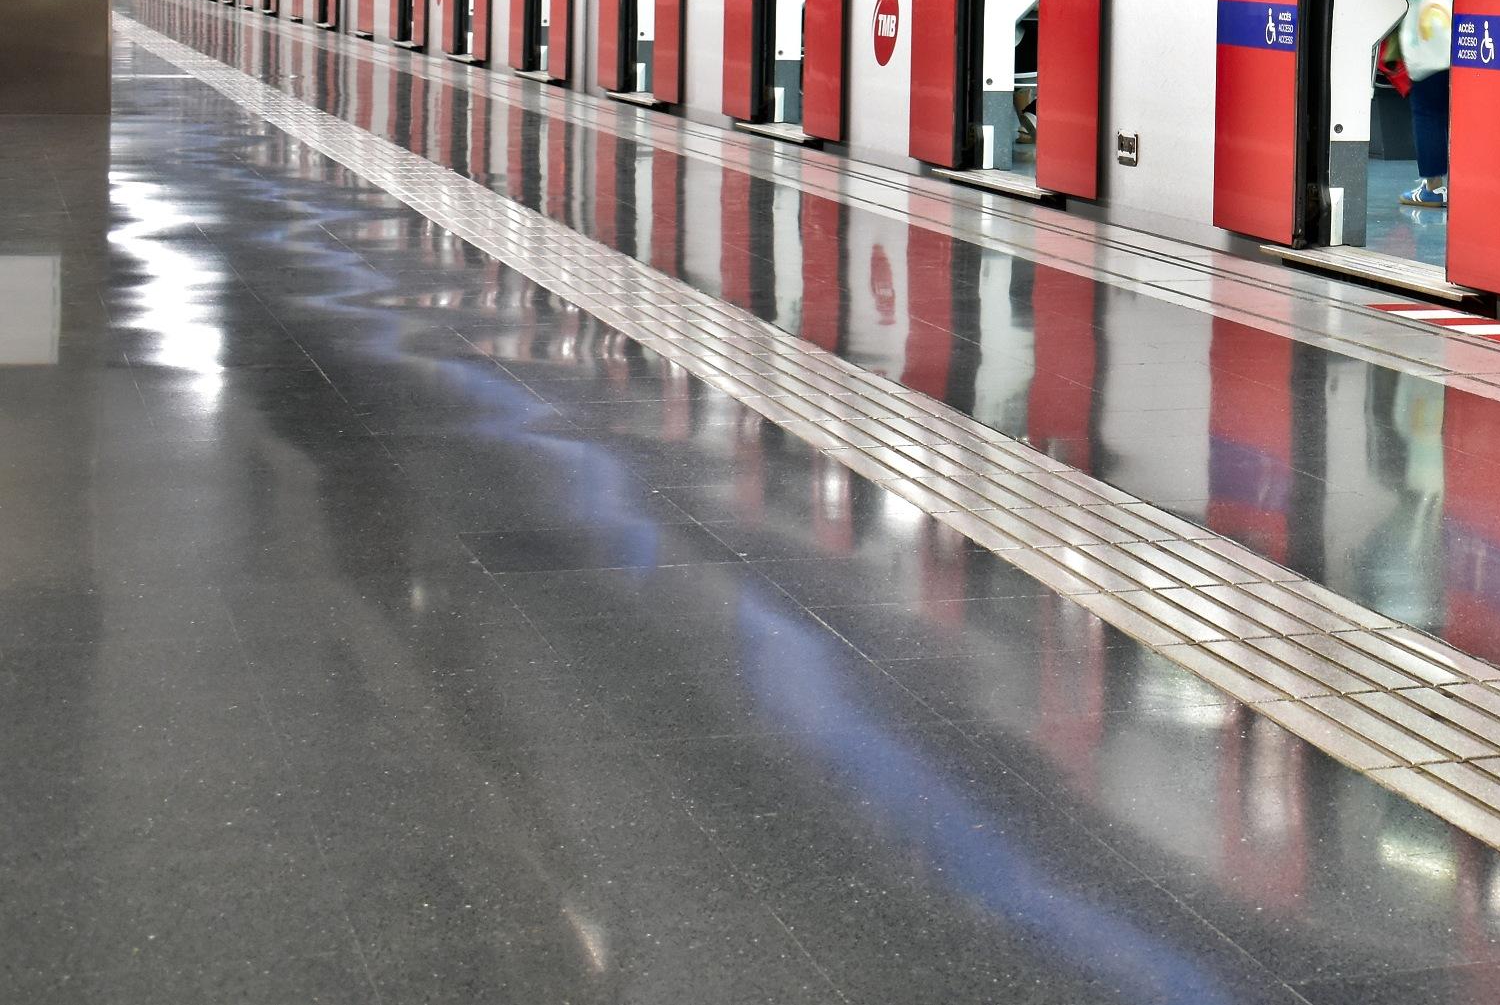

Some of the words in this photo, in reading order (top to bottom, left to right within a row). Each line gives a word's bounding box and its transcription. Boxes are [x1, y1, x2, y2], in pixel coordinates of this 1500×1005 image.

[877, 13, 896, 38] TMB
[1278, 23, 1294, 33] ACCESO
[1458, 22, 1475, 33] ACCÉS
[1278, 35, 1294, 44] ACCESS
[1458, 36, 1478, 47] ACCESO
[1458, 49, 1478, 60] ACCESS
